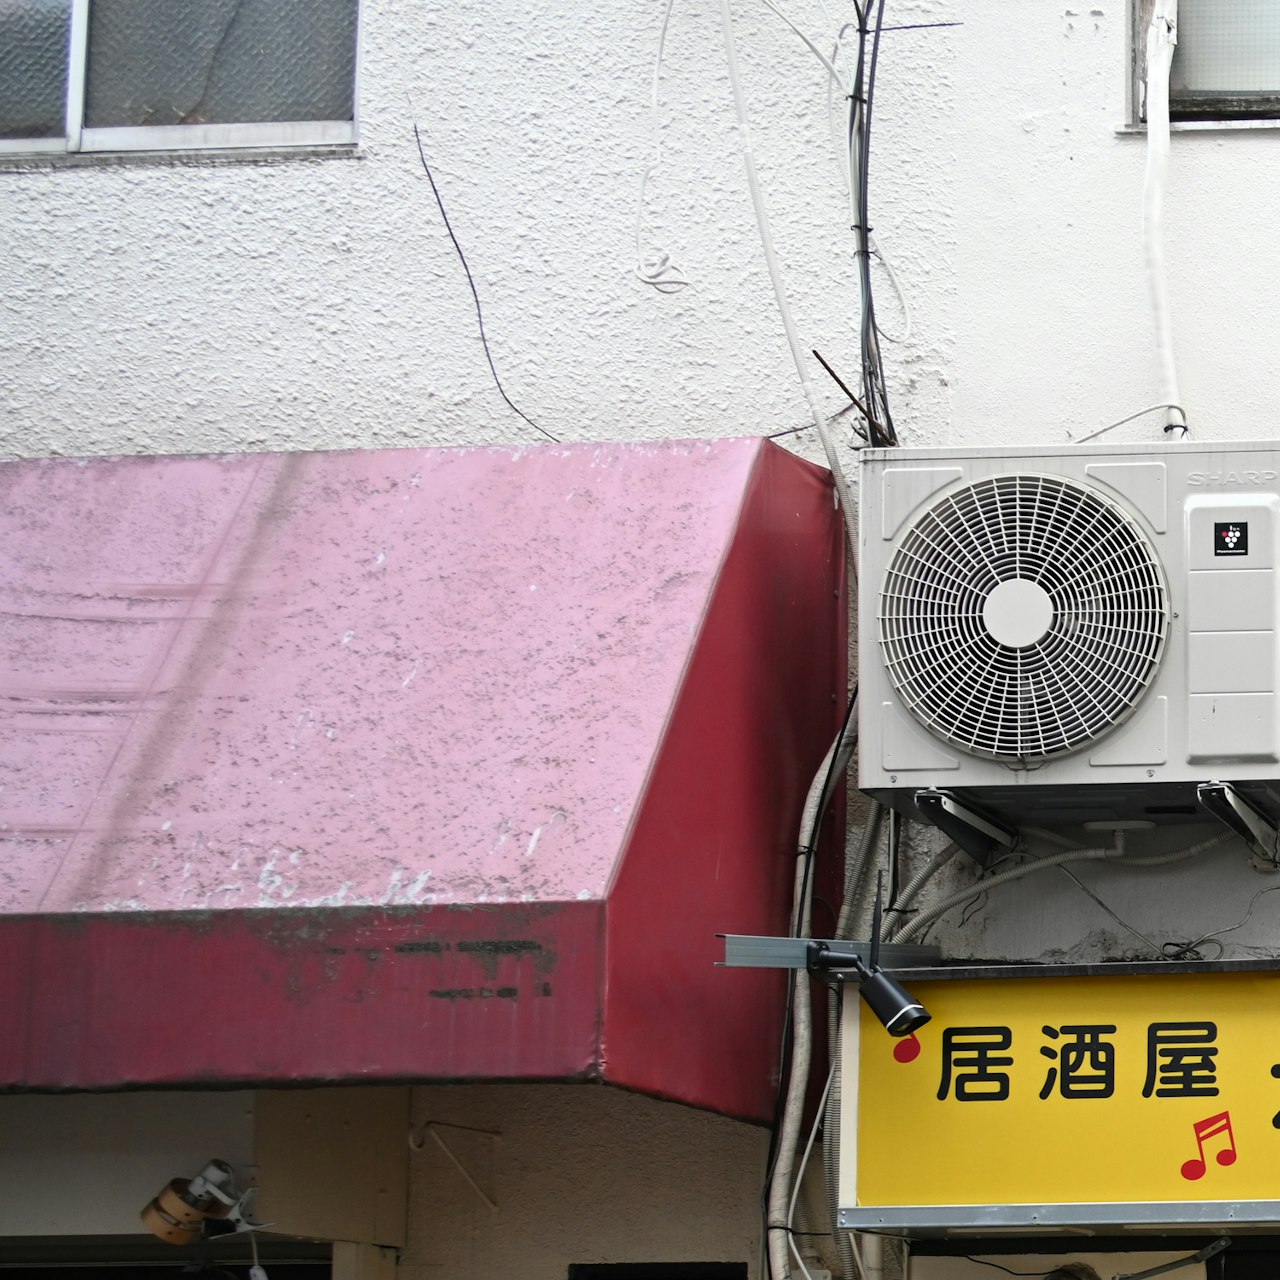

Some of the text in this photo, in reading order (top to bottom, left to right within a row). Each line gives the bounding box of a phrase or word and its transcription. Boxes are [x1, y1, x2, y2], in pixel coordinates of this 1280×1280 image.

[1187, 470, 1279, 486] SHARP
[937, 1021, 1220, 1101] 居酒屋
